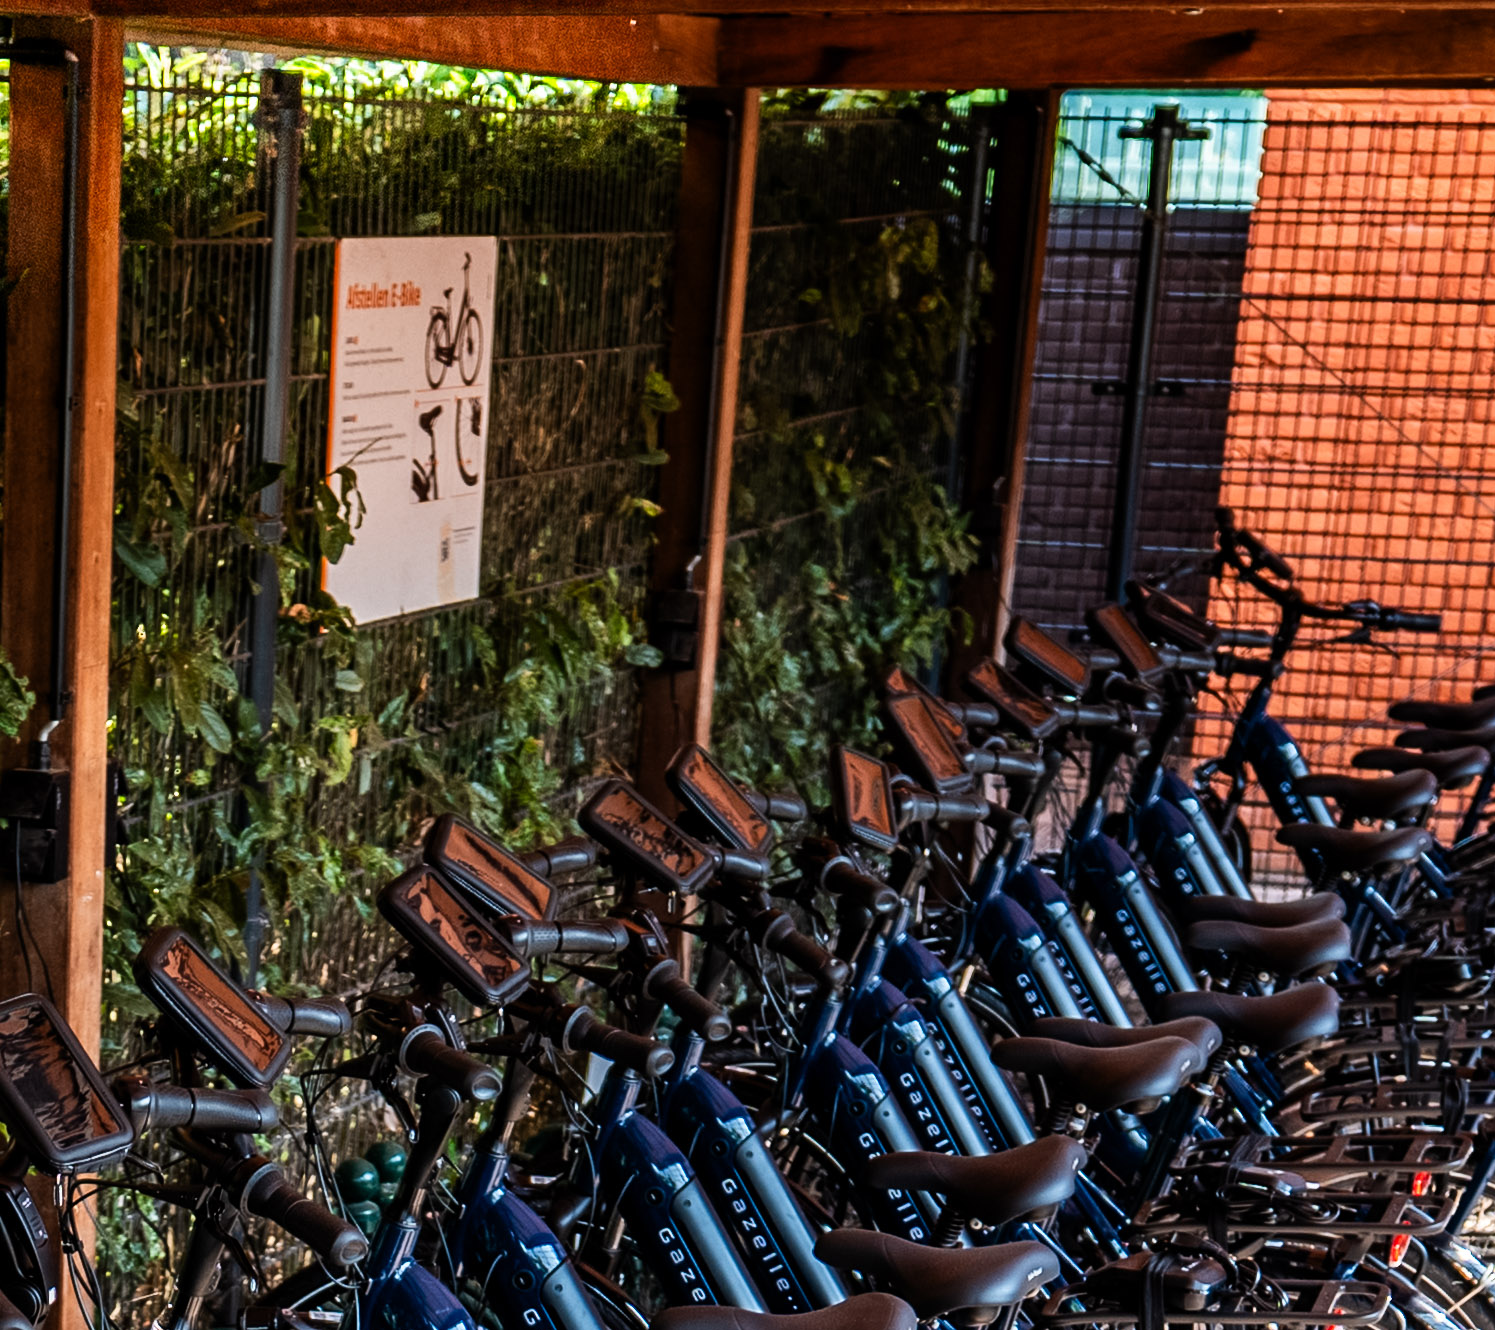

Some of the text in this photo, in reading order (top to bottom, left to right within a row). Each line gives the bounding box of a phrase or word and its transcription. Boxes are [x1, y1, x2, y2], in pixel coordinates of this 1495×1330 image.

[1116, 909, 1166, 993] Gazelle
[899, 1073, 955, 1156] Gazell
[721, 1179, 790, 1292] Gazelle
